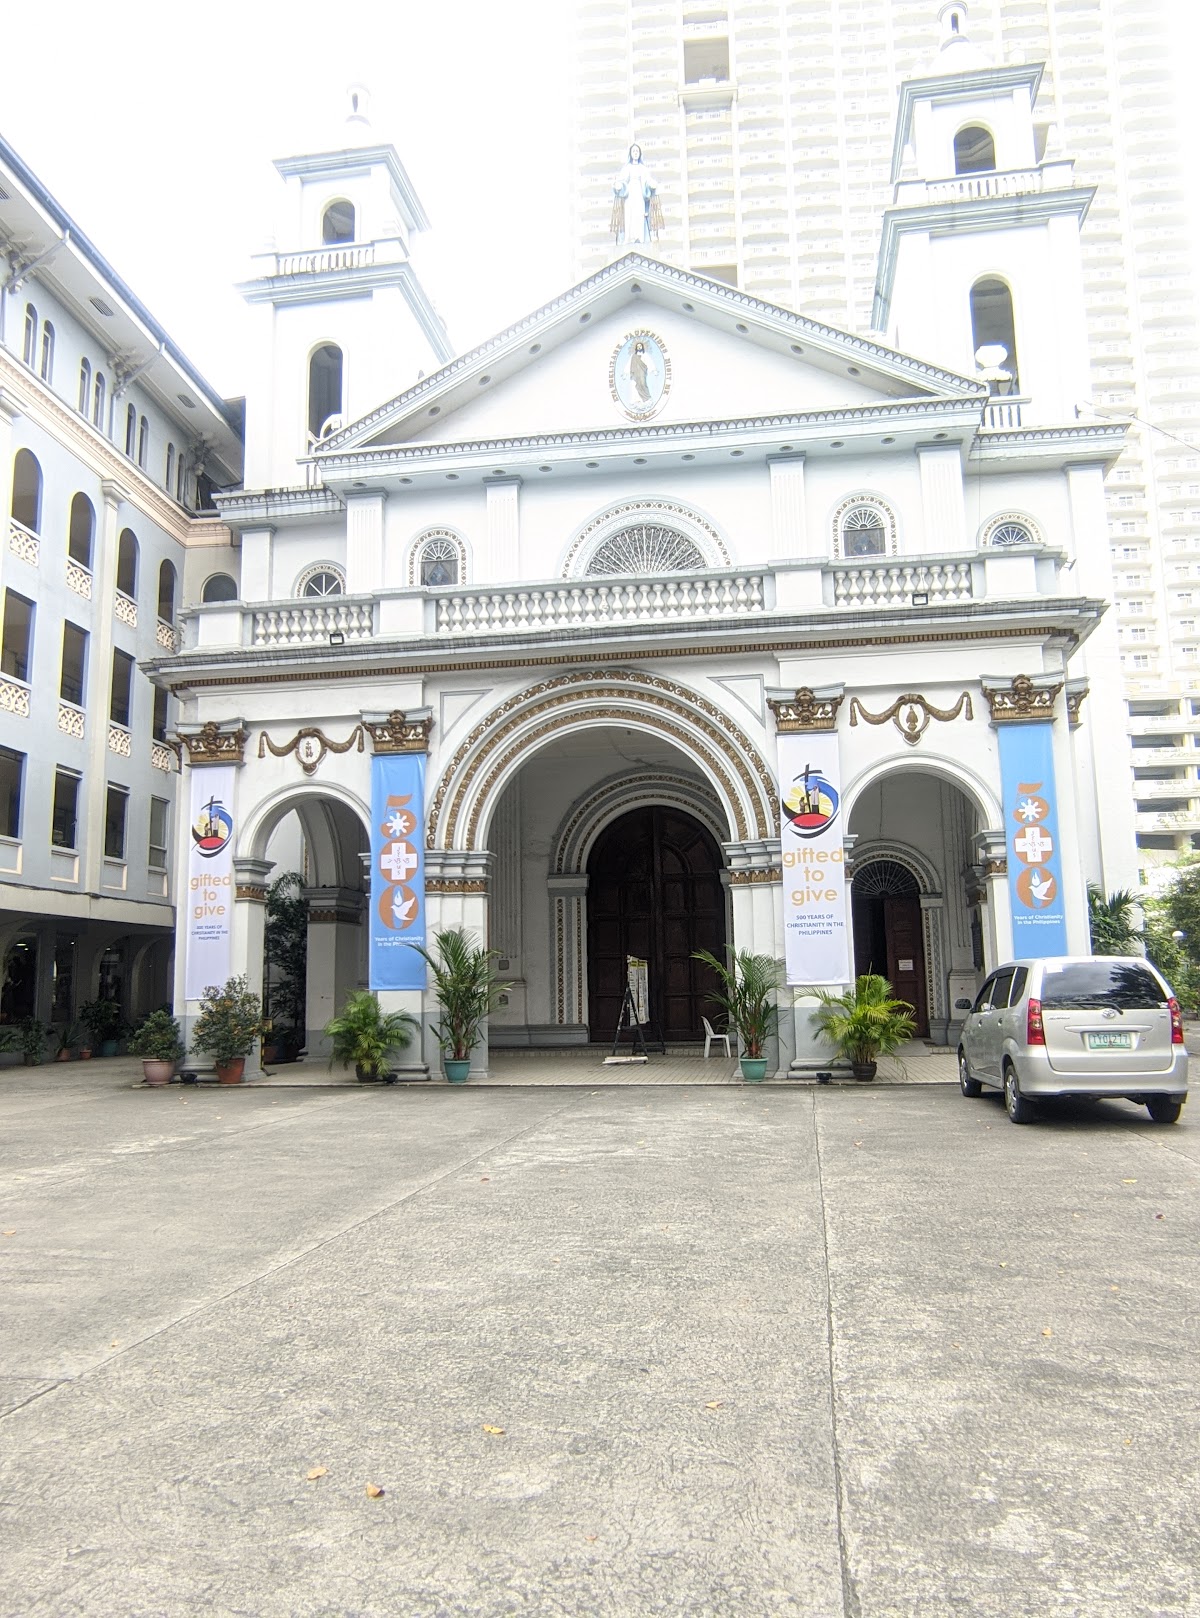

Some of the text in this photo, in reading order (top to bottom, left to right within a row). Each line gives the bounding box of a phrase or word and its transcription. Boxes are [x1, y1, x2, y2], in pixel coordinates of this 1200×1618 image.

[782, 847, 843, 868] gifted
[190, 873, 231, 890] gifted
[803, 866, 825, 882] to
[203, 889, 217, 901] to
[791, 886, 838, 906] give
[194, 903, 225, 919] give
